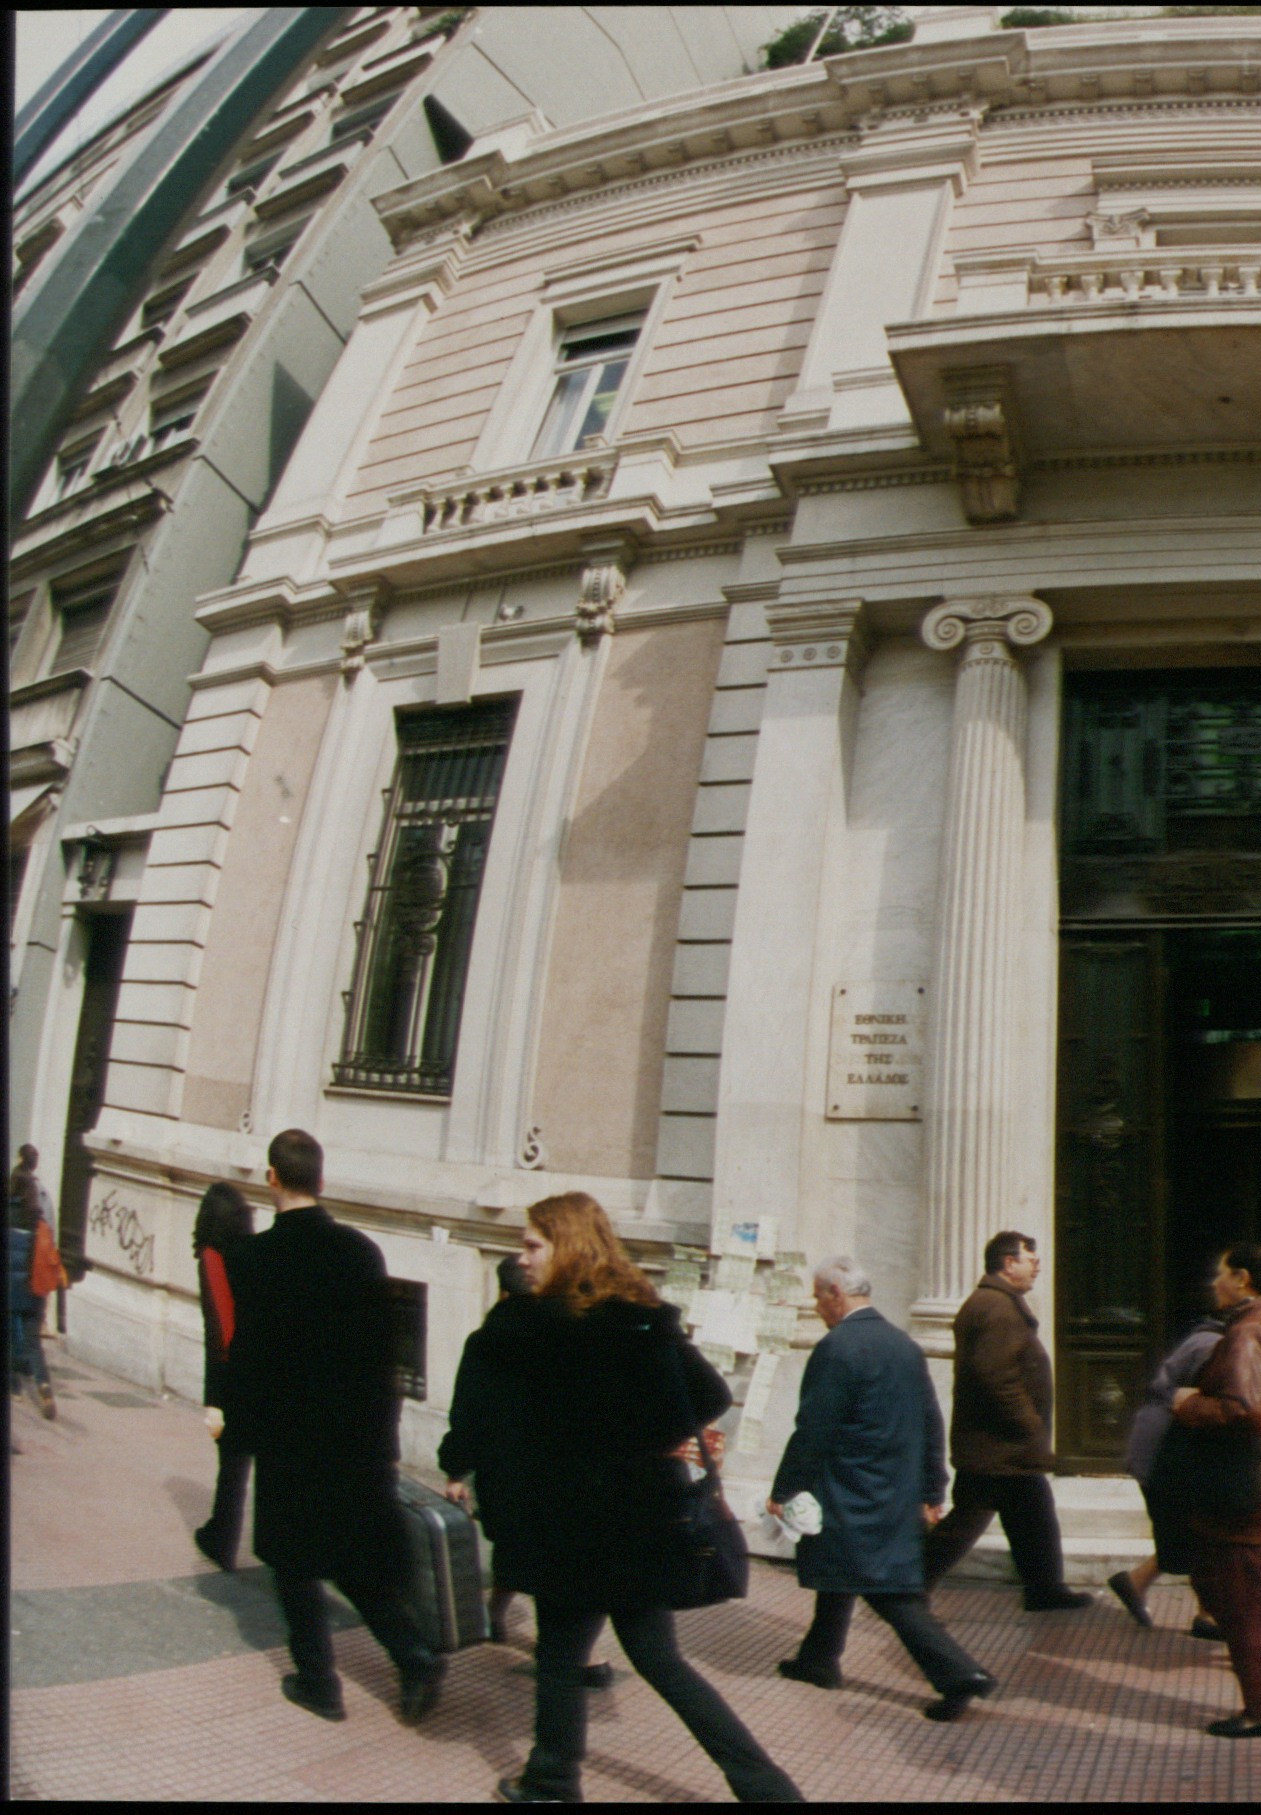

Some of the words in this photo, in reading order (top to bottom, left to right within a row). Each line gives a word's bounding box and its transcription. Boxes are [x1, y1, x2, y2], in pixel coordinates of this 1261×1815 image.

[855, 1014, 907, 1025] ΕΘΝΙΚΗ
[851, 1033, 908, 1045] ΤΡΑΠΕΖΑ
[864, 1053, 893, 1064] ΤΗΣ
[847, 1073, 910, 1084] ΕΛΛΑΔΟΣ
